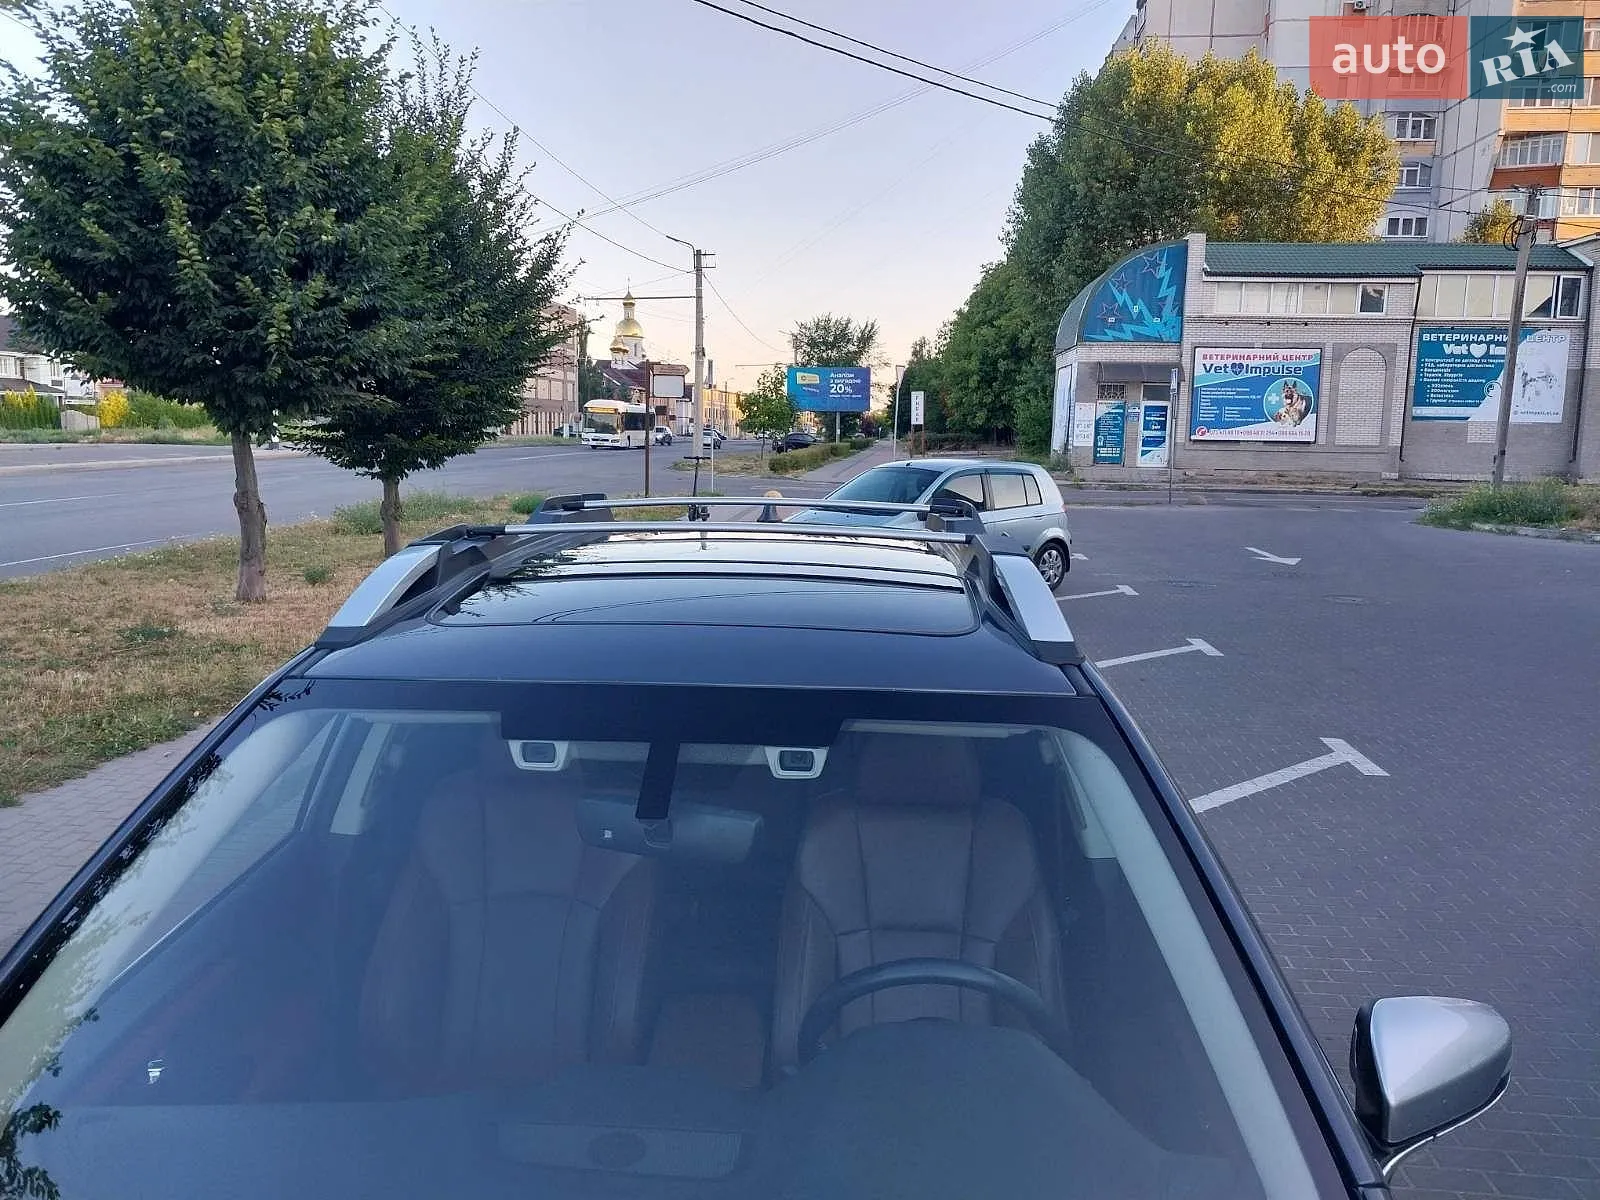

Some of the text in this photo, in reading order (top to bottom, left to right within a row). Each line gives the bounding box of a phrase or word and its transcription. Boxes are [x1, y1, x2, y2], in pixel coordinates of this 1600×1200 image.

[1422, 333, 1509, 342] ВЕТЕРИНАРНИ
[1442, 343, 1469, 355] Vet
[1202, 352, 1314, 362] ВЕТЕРИНАРНИЙ ЦЕНТР
[1202, 363, 1303, 376] Vet Impulse
[829, 383, 853, 393] 20%
